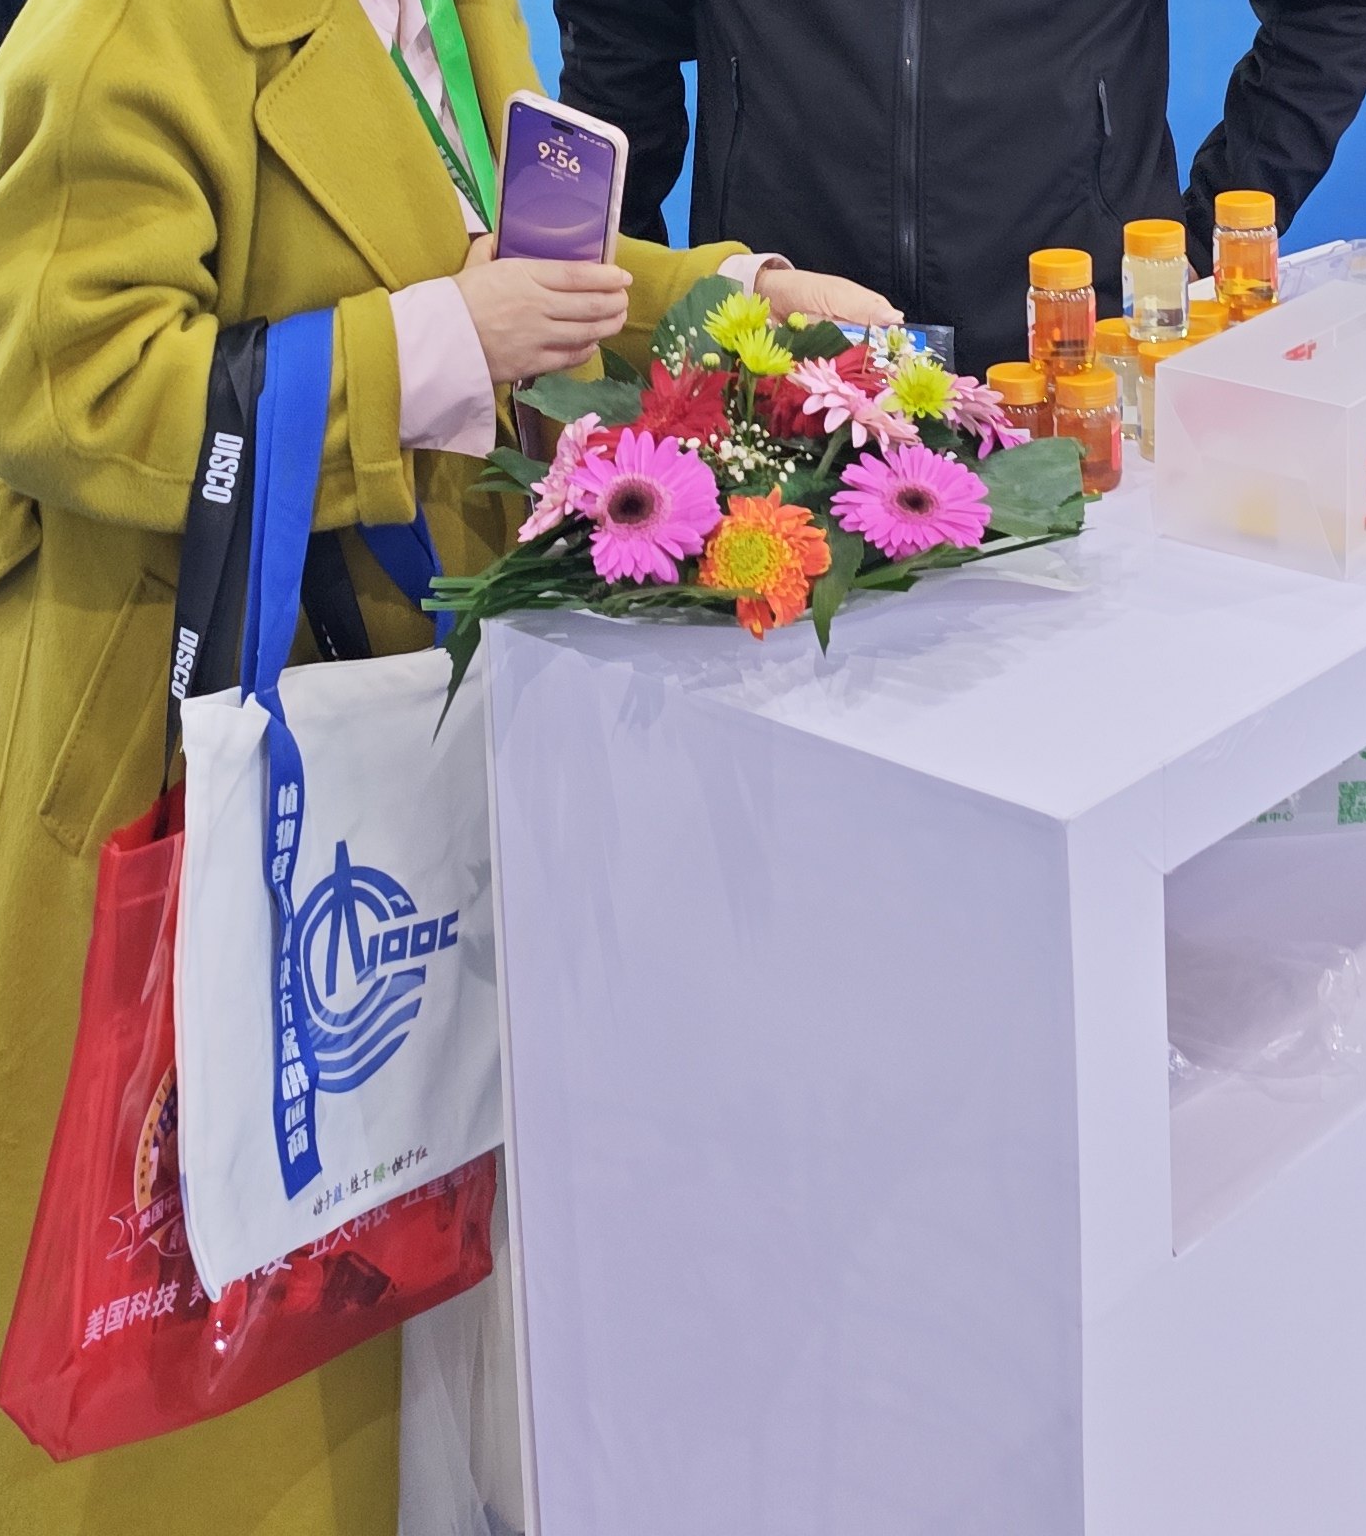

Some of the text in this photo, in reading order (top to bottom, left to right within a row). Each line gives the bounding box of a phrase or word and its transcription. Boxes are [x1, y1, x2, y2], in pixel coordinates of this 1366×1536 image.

[537, 141, 581, 174] 9:56
[202, 431, 244, 505] DISCO
[171, 625, 200, 701] DISCO
[272, 781, 310, 1165] 植物营决方案供应商
[82, 1282, 181, 1350] 美国科技
